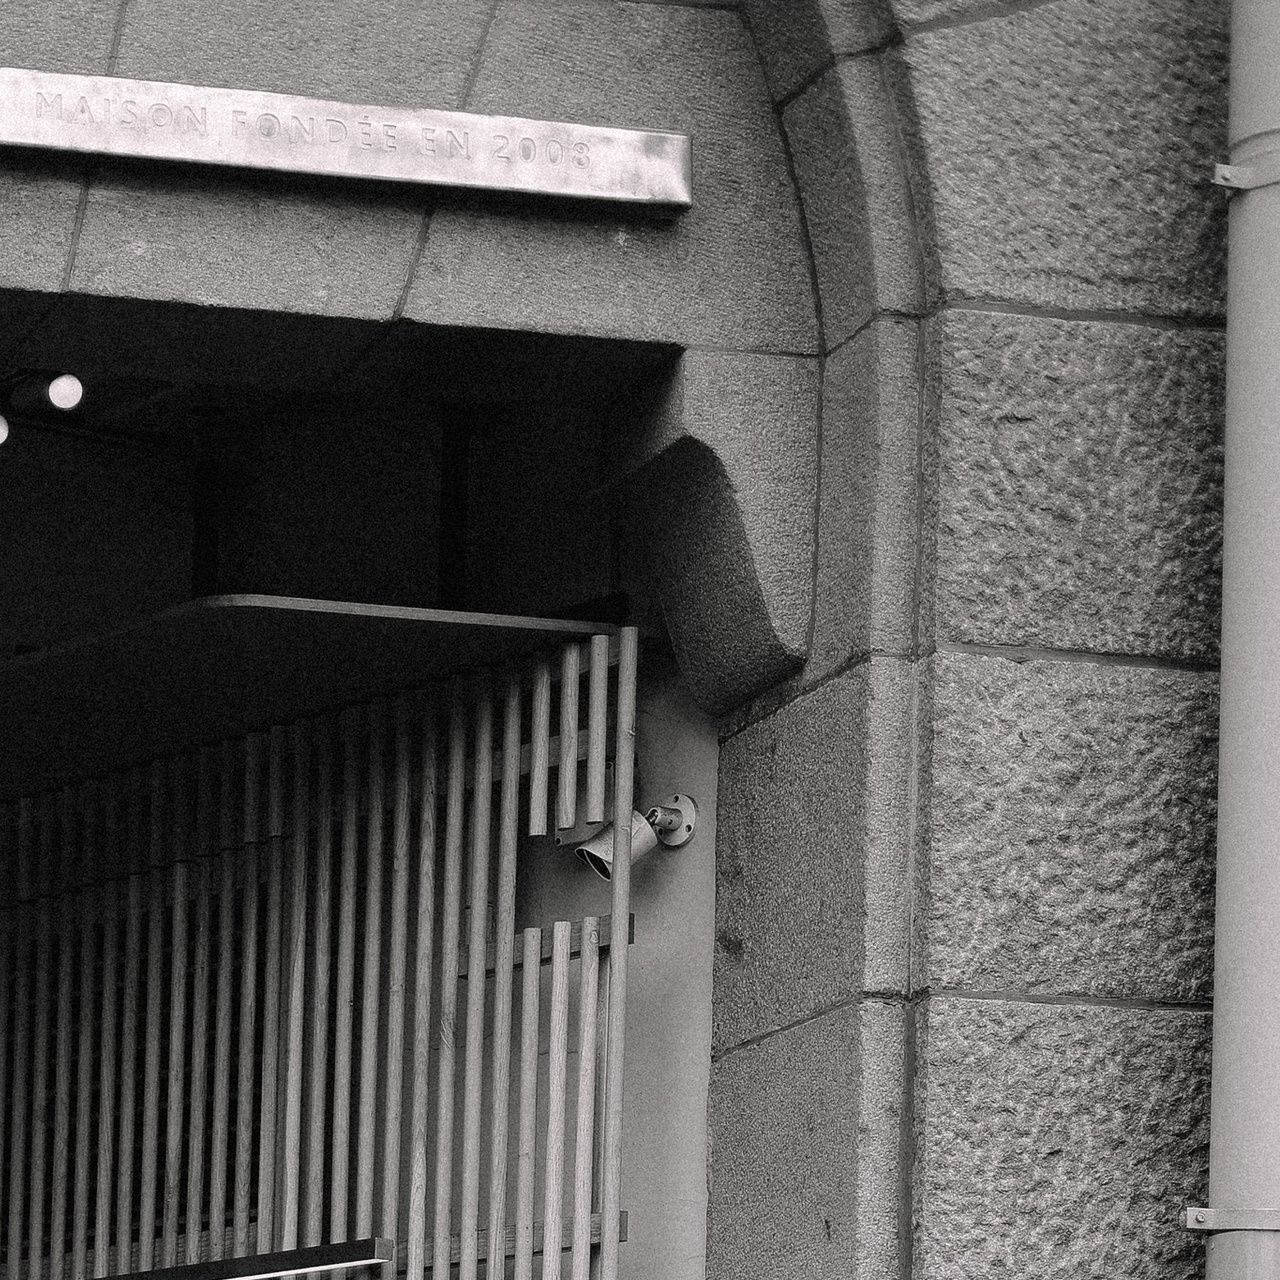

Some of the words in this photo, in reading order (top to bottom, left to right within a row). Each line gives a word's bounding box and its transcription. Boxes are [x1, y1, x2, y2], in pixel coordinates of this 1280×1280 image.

[35, 91, 208, 137] MAISON
[231, 109, 398, 152] FONDÉE
[421, 127, 470, 161] EN
[492, 134, 591, 170] 2008
